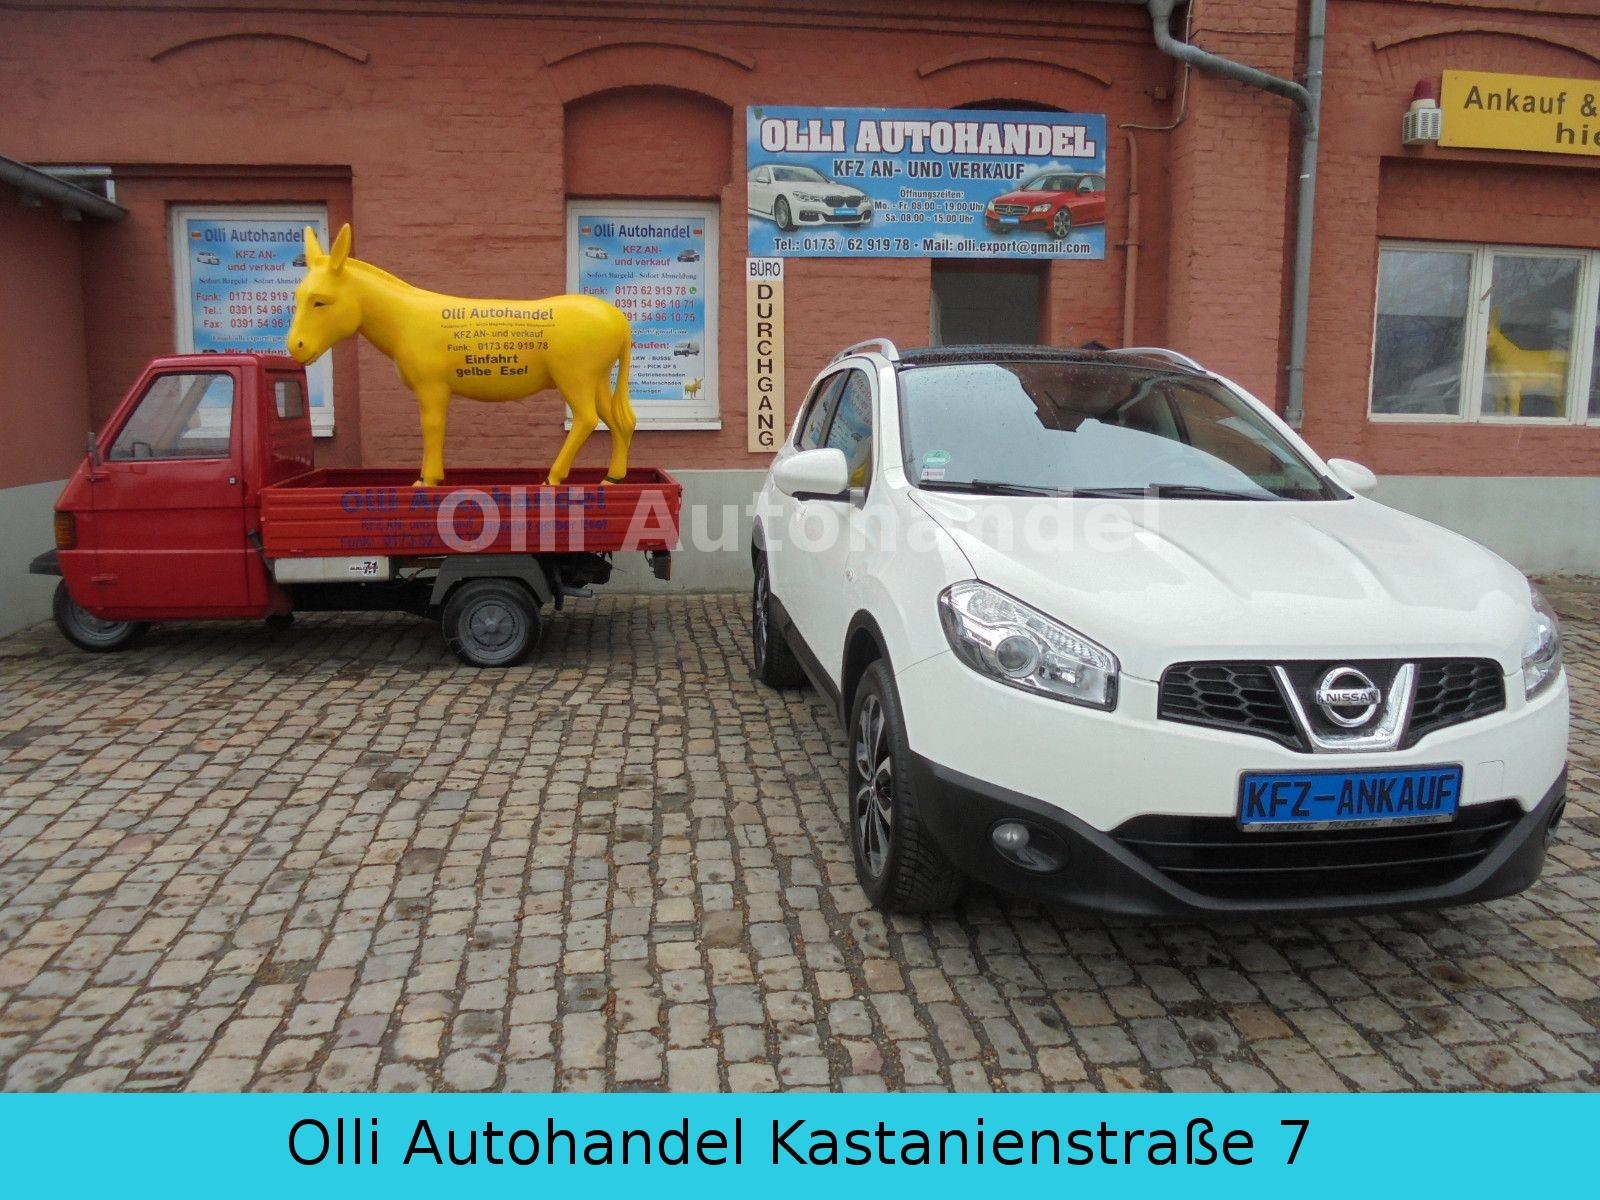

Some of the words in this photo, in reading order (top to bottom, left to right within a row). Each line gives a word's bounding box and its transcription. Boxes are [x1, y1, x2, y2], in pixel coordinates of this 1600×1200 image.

[1463, 85, 1567, 115] Ankauf
[1580, 93, 1598, 117] &
[761, 118, 846, 153] OLLI
[854, 119, 1096, 158] AUTOHANDEL
[834, 160, 865, 177] KFZ
[871, 160, 901, 177] AN-
[907, 160, 942, 178] UND
[949, 161, 1025, 180] VERKAUF
[874, 201, 890, 210] Mo.
[899, 201, 909, 210] Fr.
[970, 202, 984, 211] Uhr
[885, 213, 898, 222] Sa.
[959, 214, 973, 223] Uhr
[205, 228, 226, 242] Olli
[230, 228, 305, 242] Autohandel
[594, 223, 614, 237] Olli
[619, 225, 690, 239] Autohandel
[623, 245, 642, 254] KFZ
[645, 245, 662, 254] AN-
[774, 238, 800, 250] Tel.:
[804, 238, 836, 250] 0173
[839, 238, 844, 251] /
[848, 238, 863, 250] 62
[867, 238, 890, 250] 919
[895, 238, 910, 251] 78
[923, 239, 953, 251] Mail:
[957, 239, 1090, 255] olli.export@gmail.com
[235, 250, 255, 259] KFZ
[258, 250, 276, 259] AN-
[228, 263, 246, 271] und
[249, 263, 285, 271] verkauf
[615, 258, 632, 266] und
[635, 258, 671, 266] verkauf
[750, 260, 781, 277] BÜRO
[583, 286, 608, 295] Funk:
[615, 286, 638, 295] 0173
[641, 286, 652, 295] 62
[655, 286, 672, 295] 919
[675, 287, 686, 295] 78
[230, 292, 253, 301] 0173
[256, 292, 267, 301] 62
[271, 292, 288, 301] 919
[615, 299, 637, 308] 0391
[641, 299, 652, 308] 54
[655, 299, 666, 308] 96
[670, 299, 680, 308] 10
[684, 300, 695, 308] 71
[230, 305, 252, 314] 0391
[257, 305, 268, 314] 54
[271, 305, 283, 314] 96
[442, 308, 465, 320] Olli
[470, 308, 554, 320] Autohandel
[641, 312, 652, 321] 54
[655, 312, 667, 321] 96
[671, 312, 681, 321] 10
[684, 313, 695, 322] 75
[203, 320, 222, 328] Fax:
[231, 319, 253, 328] 0391
[257, 319, 268, 328] 54
[272, 319, 283, 328] 96
[454, 331, 471, 339] KFZ
[473, 330, 490, 338] AN-
[492, 330, 509, 338] und
[511, 330, 544, 338] verkauf
[447, 344, 470, 352] Funk:
[478, 342, 501, 350] 0173
[503, 342, 515, 350] 62
[518, 342, 535, 350] 919
[537, 342, 549, 350] 78
[465, 354, 519, 365] Einfahrt
[757, 284, 774, 447] DURCHGANG
[456, 366, 492, 378] gelbe
[500, 366, 528, 376] Esel
[340, 487, 398, 513] Olli
[1326, 692, 1377, 702] NISSAN
[1247, 774, 1455, 817] KFZ-ANKAUF
